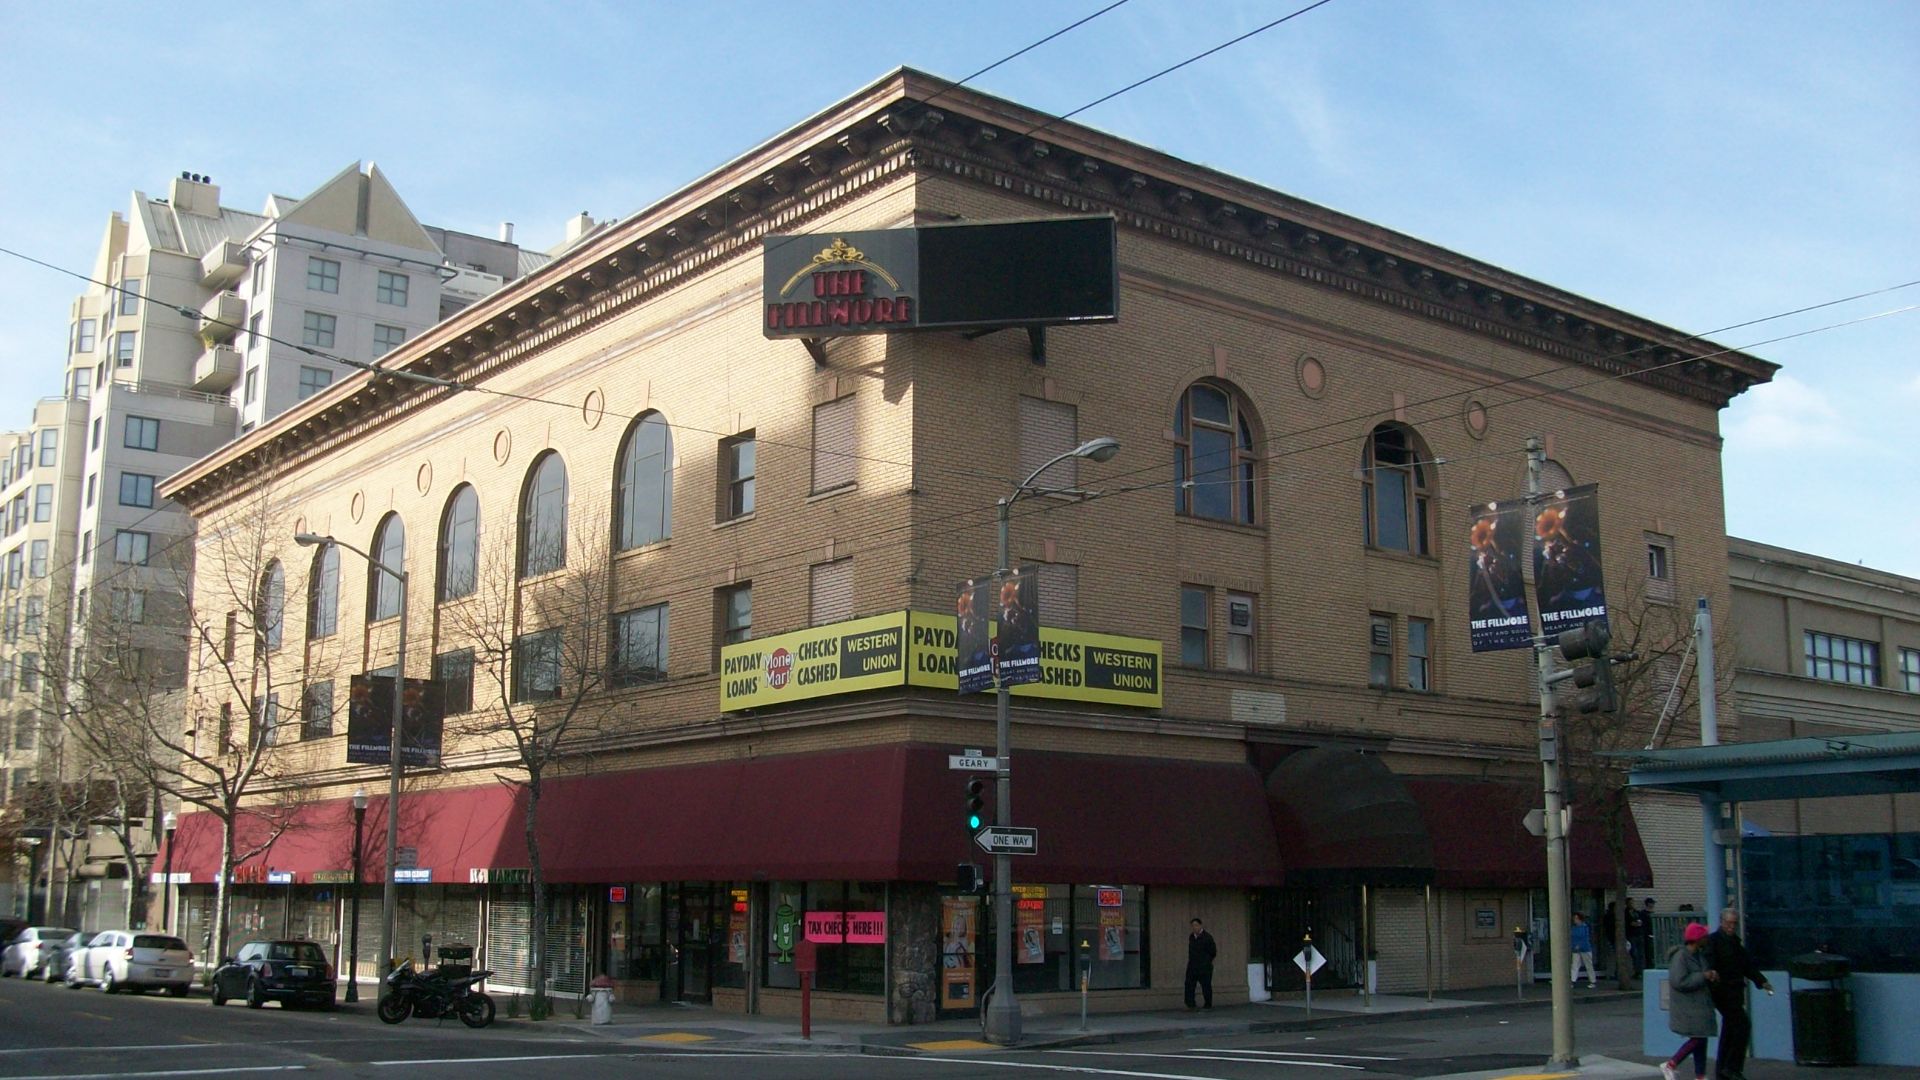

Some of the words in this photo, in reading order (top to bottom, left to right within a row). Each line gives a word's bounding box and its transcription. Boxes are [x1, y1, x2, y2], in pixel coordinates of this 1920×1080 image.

[812, 269, 866, 298] THE
[768, 296, 911, 330] FILLMORE
[1471, 620, 1487, 630] THE
[1487, 616, 1529, 628] FILLMORE
[1541, 611, 1559, 622] THE
[1560, 606, 1606, 620] FILLMORE
[847, 632, 897, 653] WESTERN
[914, 626, 958, 649] PAYD
[798, 637, 838, 661] CHECKS
[1040, 641, 1081, 663] HECKS
[724, 652, 762, 675] PAYDAY
[763, 652, 798, 672] Money
[863, 654, 896, 671] UNION
[918, 653, 959, 676] LOAN
[1000, 660, 1010, 669] THE
[1011, 657, 1038, 667] FILLMORE
[1093, 651, 1152, 670] WESTERN
[764, 670, 791, 688] Mart
[797, 663, 838, 686] CASHED
[959, 669, 968, 677] THE
[968, 664, 990, 676] FILLMORE
[1040, 666, 1082, 688] ASHED
[727, 677, 758, 698] LOANS
[1113, 673, 1152, 689] UNION
[361, 744, 391, 752] FILLMORE
[959, 759, 989, 768] GEARY
[993, 835, 1009, 845] ONE
[1012, 836, 1029, 846] WAY
[808, 921, 821, 935] TAX
[824, 921, 850, 935] CHECS
[853, 921, 883, 936] HERE!!!
